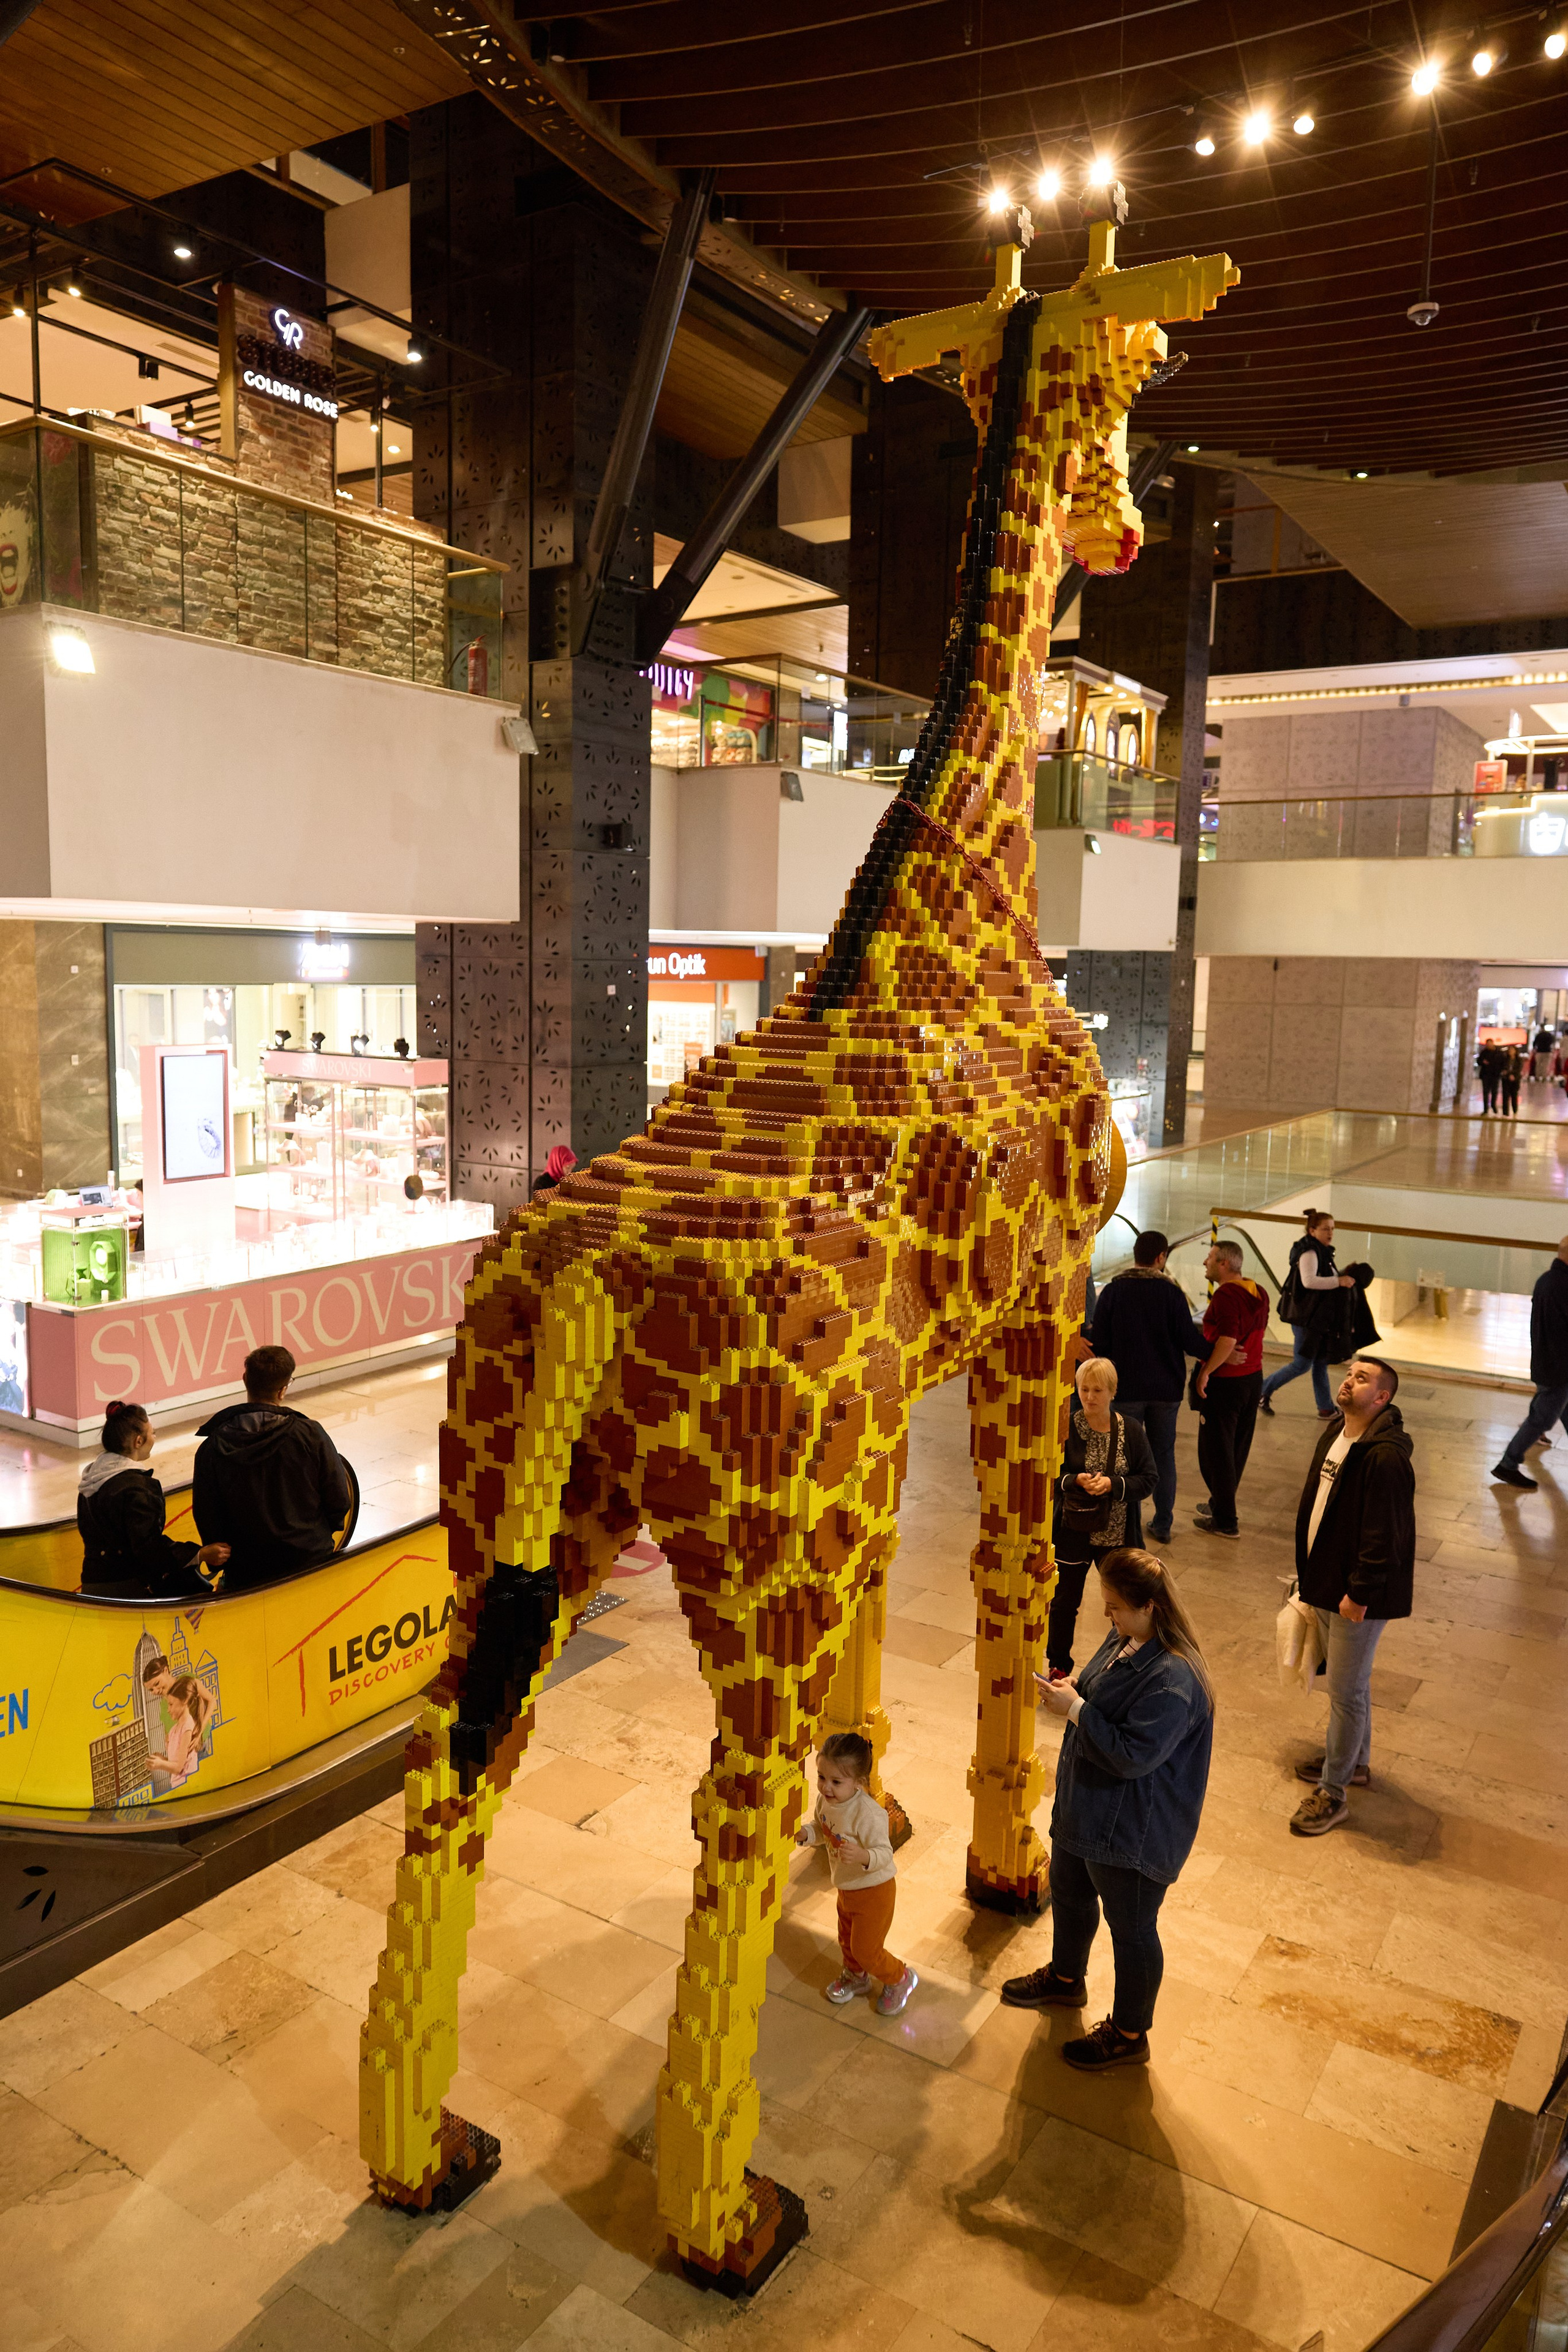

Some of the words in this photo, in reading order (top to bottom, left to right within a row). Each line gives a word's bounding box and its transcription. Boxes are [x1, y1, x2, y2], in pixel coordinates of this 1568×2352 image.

[237, 334, 336, 394] STUDIO
[243, 370, 301, 404] GOLDEN
[304, 393, 338, 418] ROSE
[645, 957, 666, 974] un
[668, 952, 706, 979] Optik
[301, 1057, 372, 1078] SWAROVSKI
[90, 1251, 474, 1402] SWAROVSK
[328, 1594, 458, 1683] LEGOLA
[328, 1641, 435, 1706] DISCOVERY
